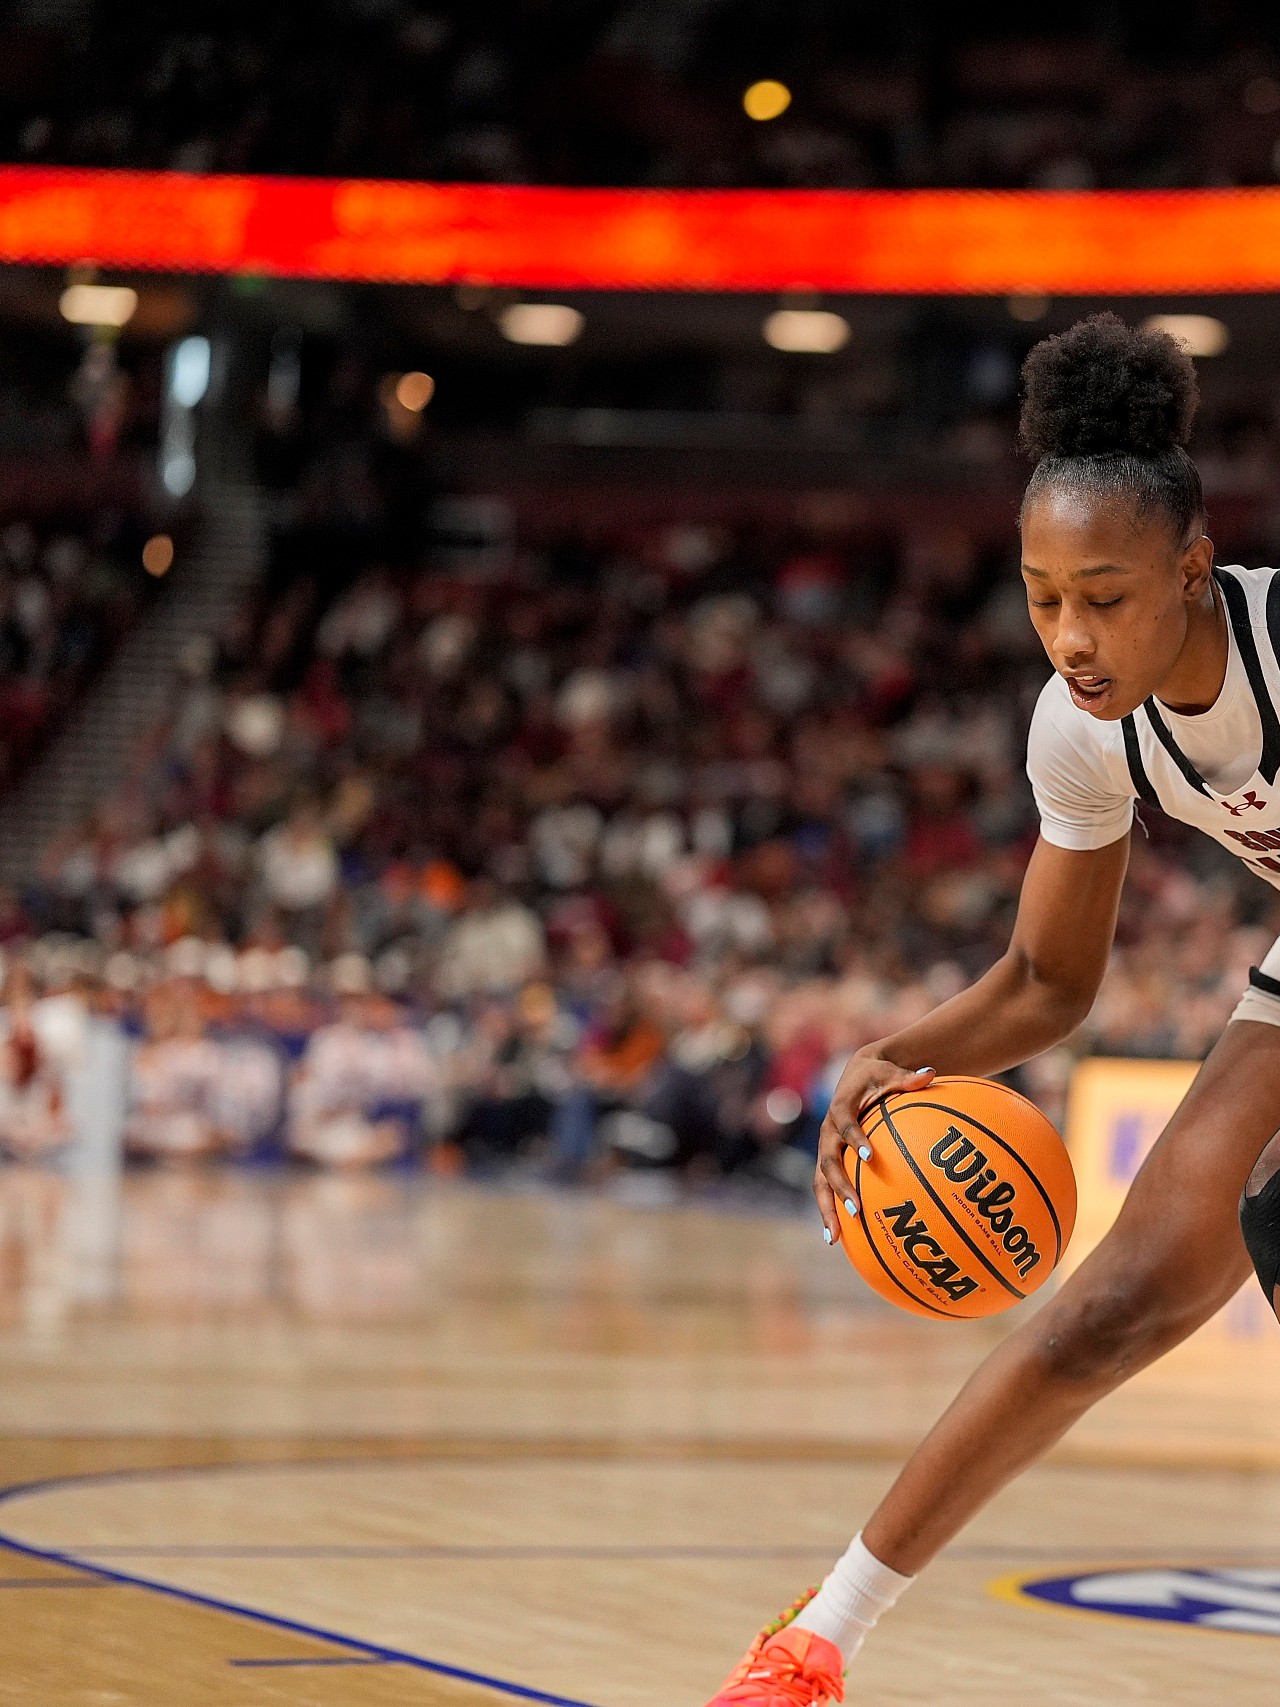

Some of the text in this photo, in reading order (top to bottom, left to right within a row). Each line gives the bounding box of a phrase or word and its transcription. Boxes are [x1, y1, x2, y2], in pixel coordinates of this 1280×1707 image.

[881, 1199, 981, 1302] NCAA
[928, 1124, 1041, 1279] Wilson
[952, 1192, 1003, 1257] INDOOR GAME BALL
[874, 1211, 949, 1306] OFFICIAL GAME BALL
